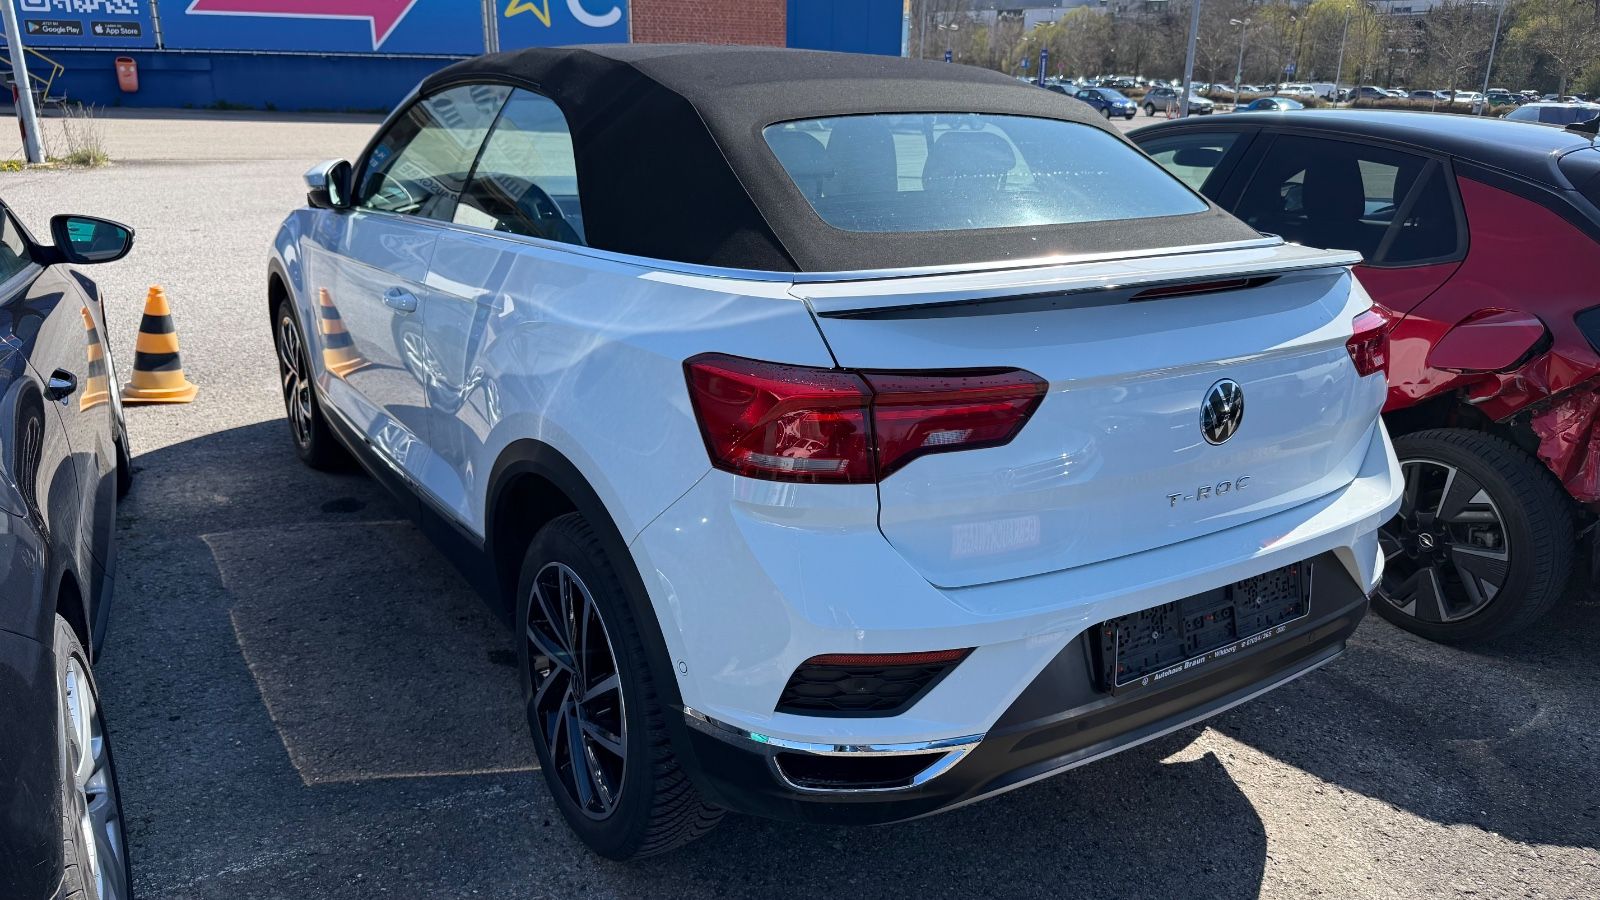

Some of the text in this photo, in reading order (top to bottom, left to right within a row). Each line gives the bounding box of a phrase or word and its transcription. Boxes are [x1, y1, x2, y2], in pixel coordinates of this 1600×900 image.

[42, 25, 80, 34] Google Play
[1166, 475, 1251, 507] T-ROC
[1154, 665, 1183, 681] Autohaus
[1184, 656, 1206, 670] Braun
